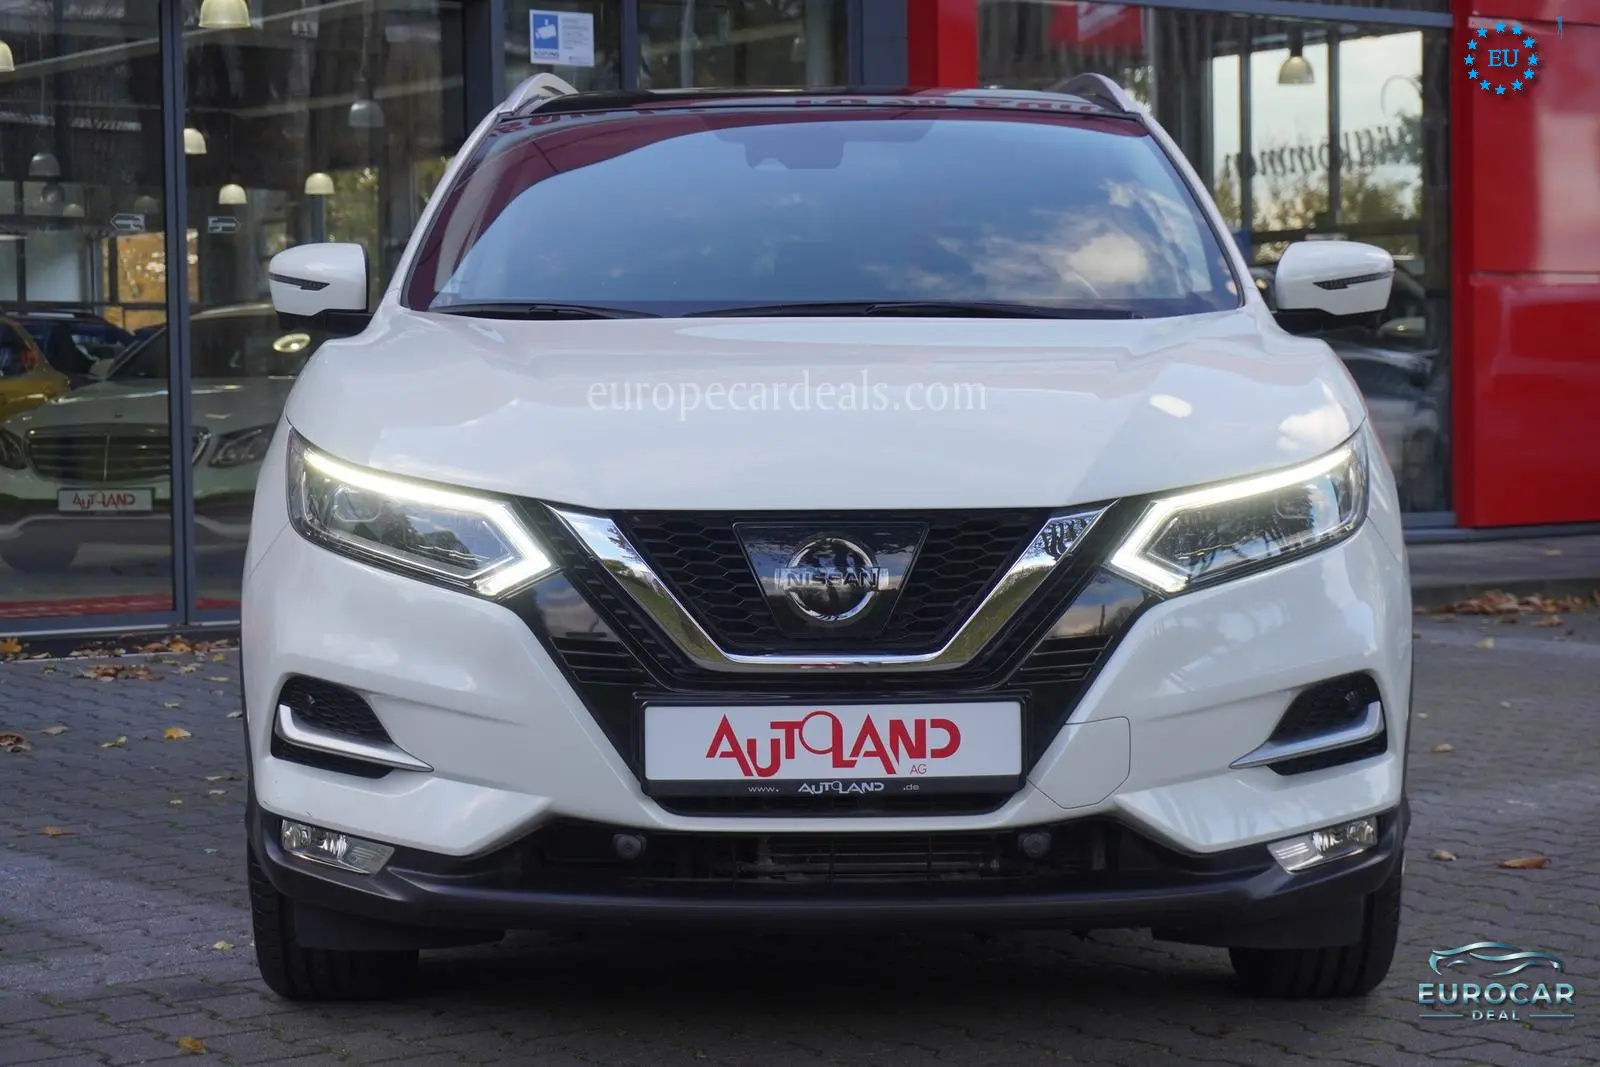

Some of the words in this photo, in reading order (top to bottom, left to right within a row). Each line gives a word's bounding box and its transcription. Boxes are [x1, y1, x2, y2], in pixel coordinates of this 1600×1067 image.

[785, 568, 880, 588] NISSAN
[705, 710, 961, 777] AUTOLAND
[909, 763, 927, 777] AG
[903, 783, 920, 791] .de
